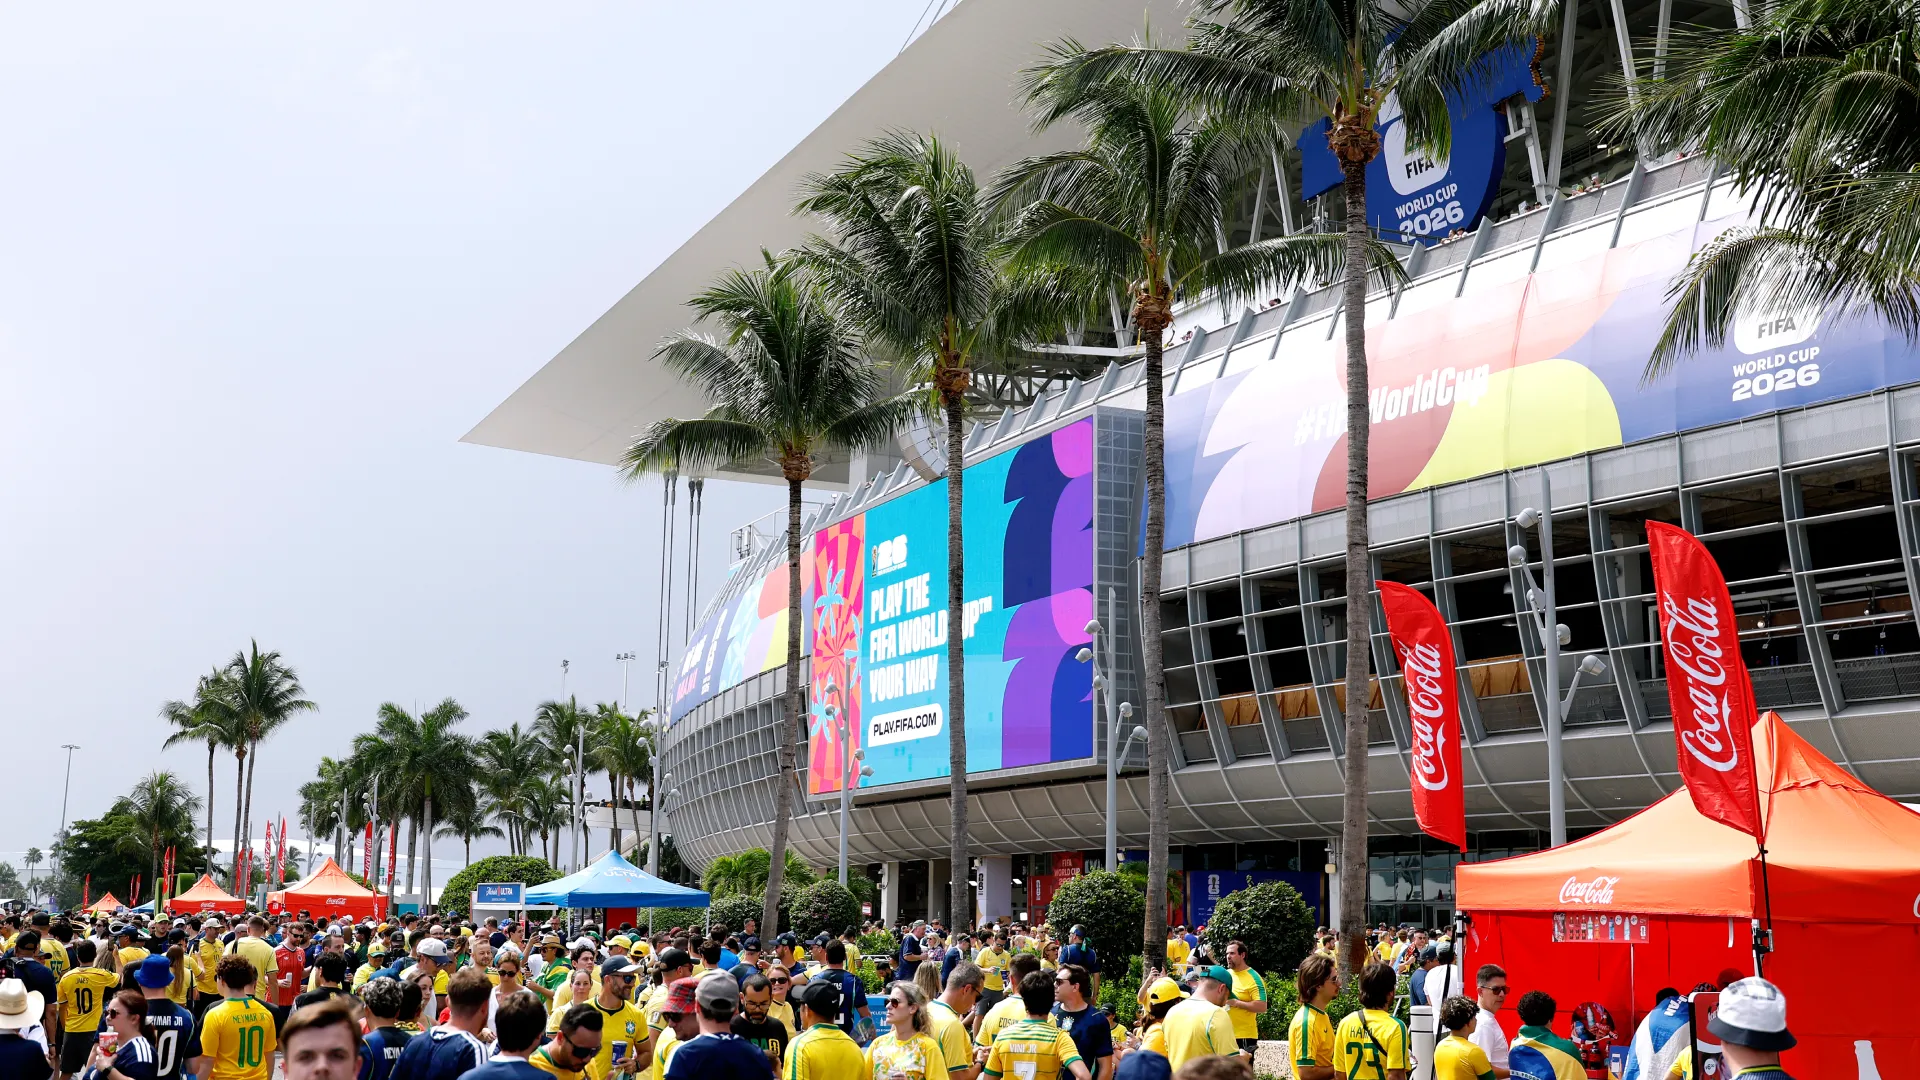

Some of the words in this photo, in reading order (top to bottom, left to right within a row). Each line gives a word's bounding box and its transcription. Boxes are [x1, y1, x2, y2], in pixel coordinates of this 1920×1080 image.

[1405, 157, 1435, 179] FIFA
[1395, 194, 1435, 219] WORLD
[1435, 183, 1458, 203] CUP
[1399, 200, 1464, 243] 2026
[1757, 317, 1796, 339] FIFA
[1732, 354, 1786, 378] WORLD
[1788, 346, 1820, 364] CUP
[1732, 363, 1820, 402] 2026
[870, 580, 904, 624] PLAY
[905, 572, 930, 614] THE
[869, 623, 897, 664] FIFA
[898, 609, 948, 656] WORLD
[869, 663, 904, 704] YOUR
[905, 653, 939, 695] WAY
[873, 712, 937, 737] PLAY.FIFA.COM
[1055, 868, 1070, 877] WORLD
[500, 887, 513, 896] ULTRA
[1558, 875, 1621, 905] Coca-Cola
[74, 988, 93, 1015] 10
[173, 1016, 184, 1027] JR
[233, 1014, 258, 1025] NEYMAR
[237, 1025, 265, 1068] 10
[1009, 1043, 1025, 1054] VINI
[1027, 1044, 1038, 1054] JR
[1013, 1060, 1037, 1080] 7
